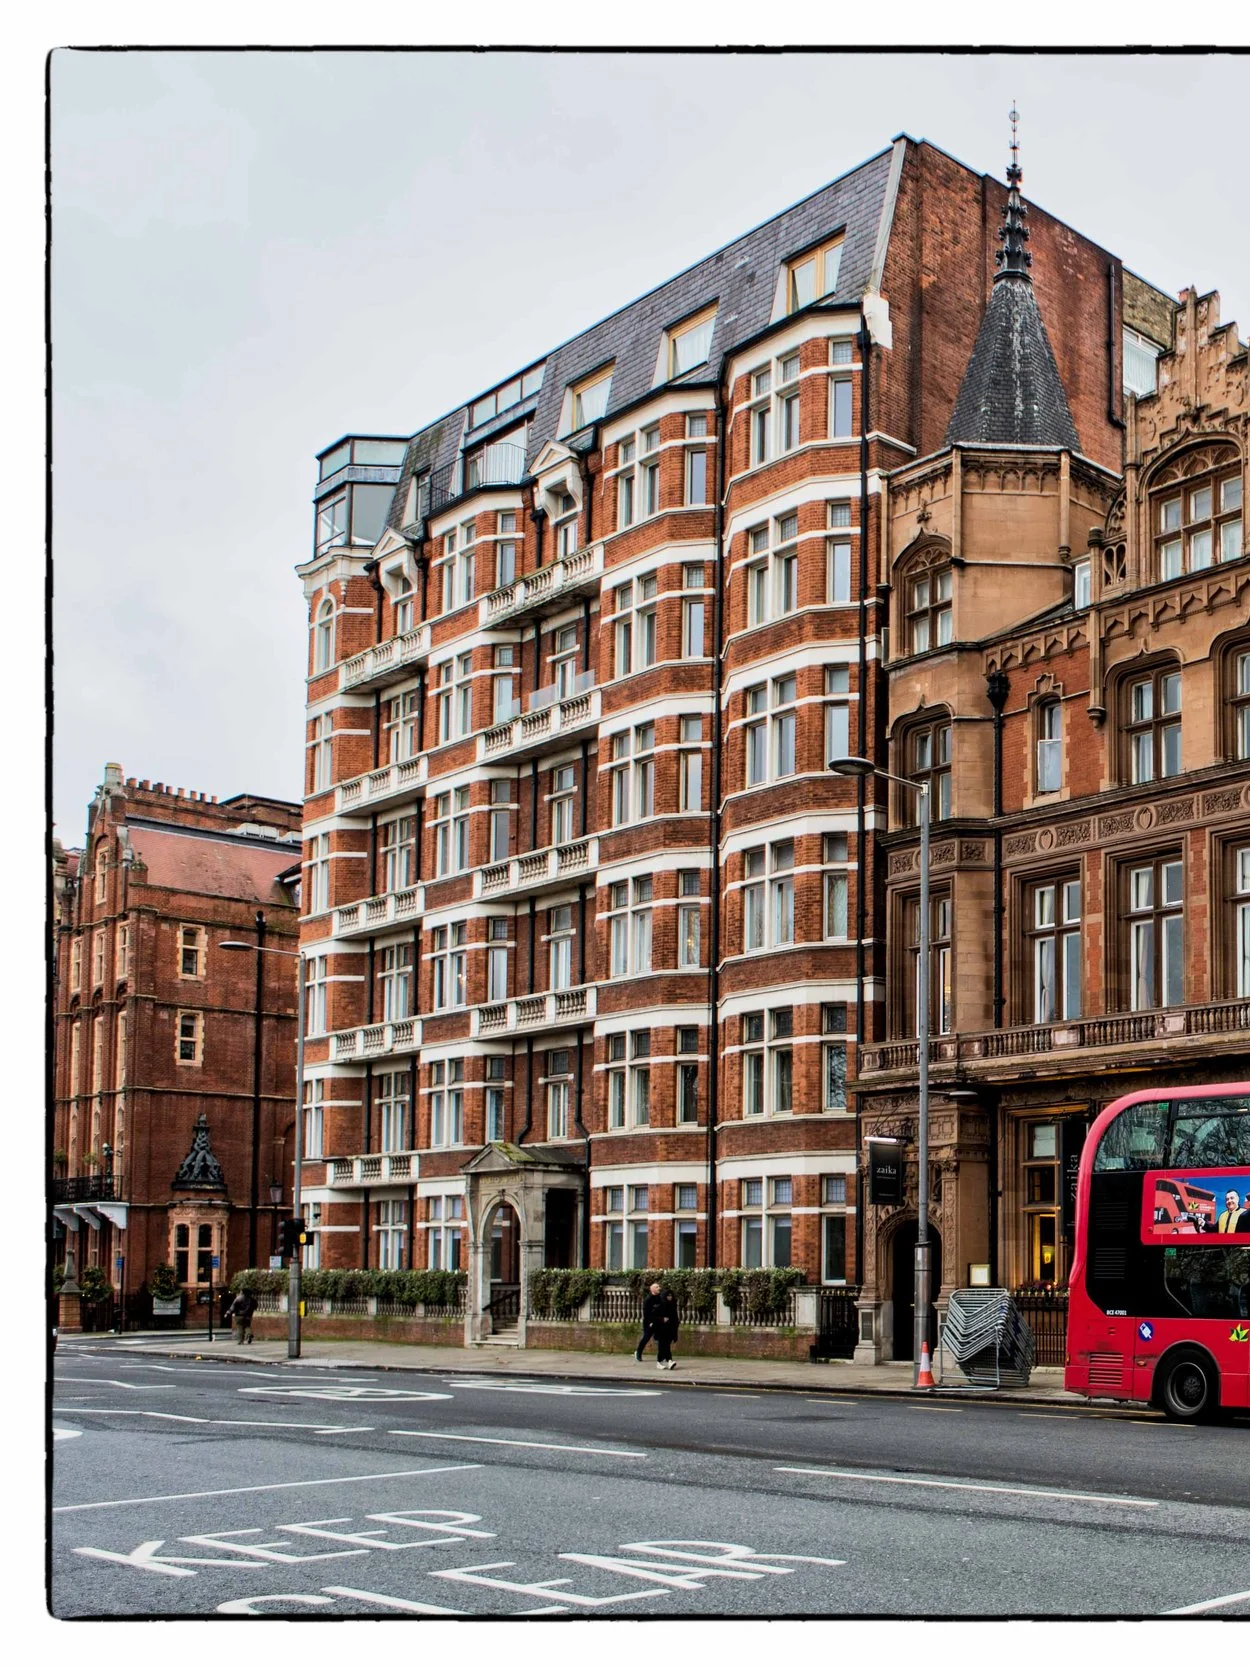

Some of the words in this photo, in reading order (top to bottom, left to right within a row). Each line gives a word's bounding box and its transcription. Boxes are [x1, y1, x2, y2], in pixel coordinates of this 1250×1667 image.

[876, 1165, 897, 1175] zaika
[1066, 1154, 1079, 1202] zaika
[71, 1509, 499, 1577] KEEP
